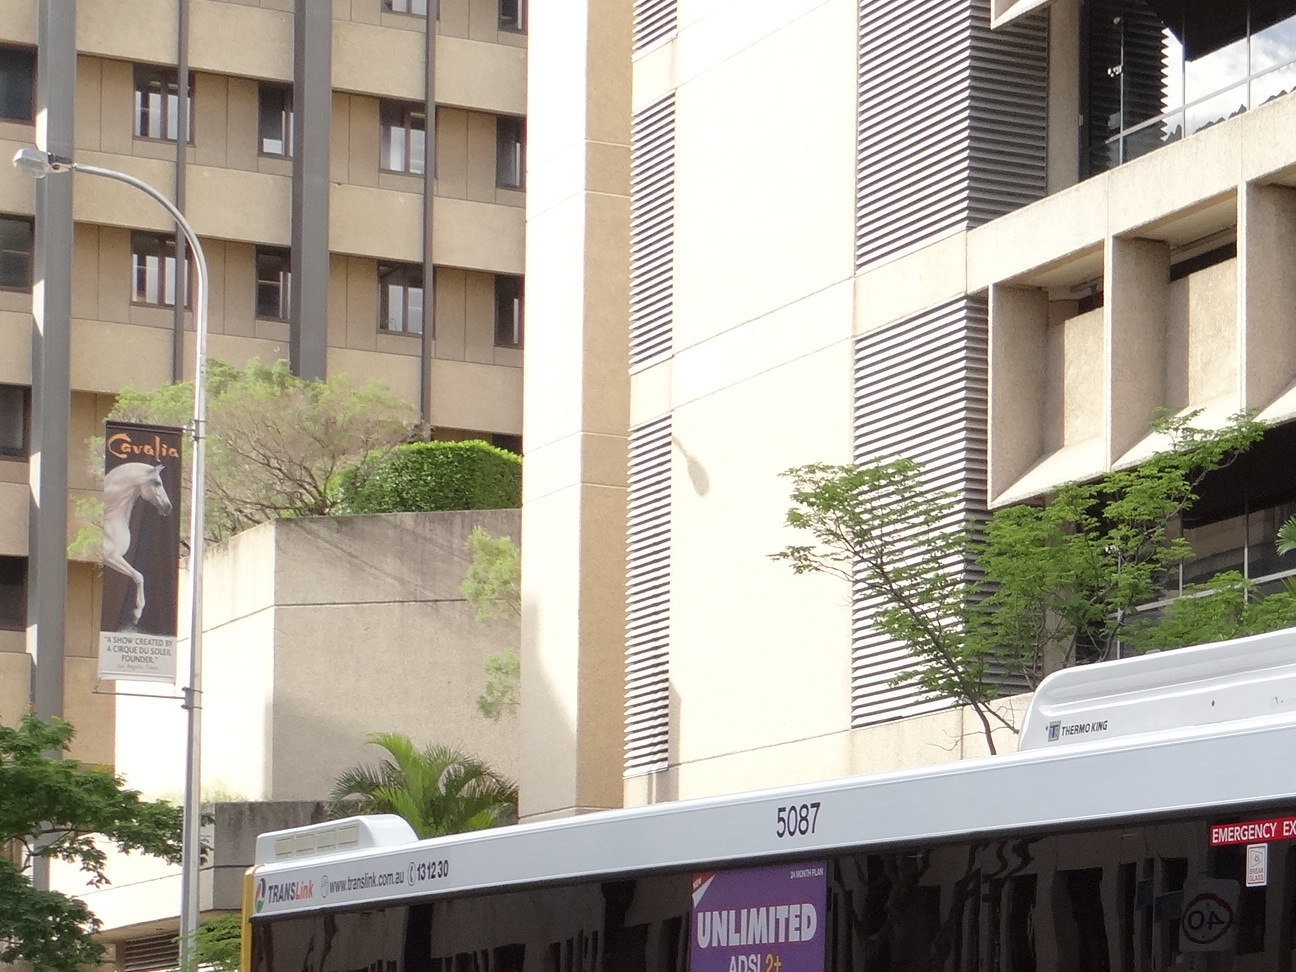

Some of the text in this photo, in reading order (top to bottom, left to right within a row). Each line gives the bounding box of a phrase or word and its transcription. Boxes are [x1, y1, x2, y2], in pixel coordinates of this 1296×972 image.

[107, 432, 179, 462] Cavalia
[113, 636, 133, 644] SHOW
[135, 637, 164, 647] CREATED
[165, 639, 174, 647] BY
[113, 645, 138, 654] CIRQUE
[139, 646, 149, 655] DU
[150, 647, 172, 656] SOLEIL
[1062, 723, 1091, 737] THERMO
[1091, 720, 1109, 733] KING
[776, 801, 821, 839] 5087
[1211, 822, 1277, 844] EMERGENCY
[329, 870, 405, 894] www.translink.com.au
[812, 867, 824, 877] PLAN
[268, 879, 315, 904] TRANSLink
[696, 902, 818, 949] UNLIMITED
